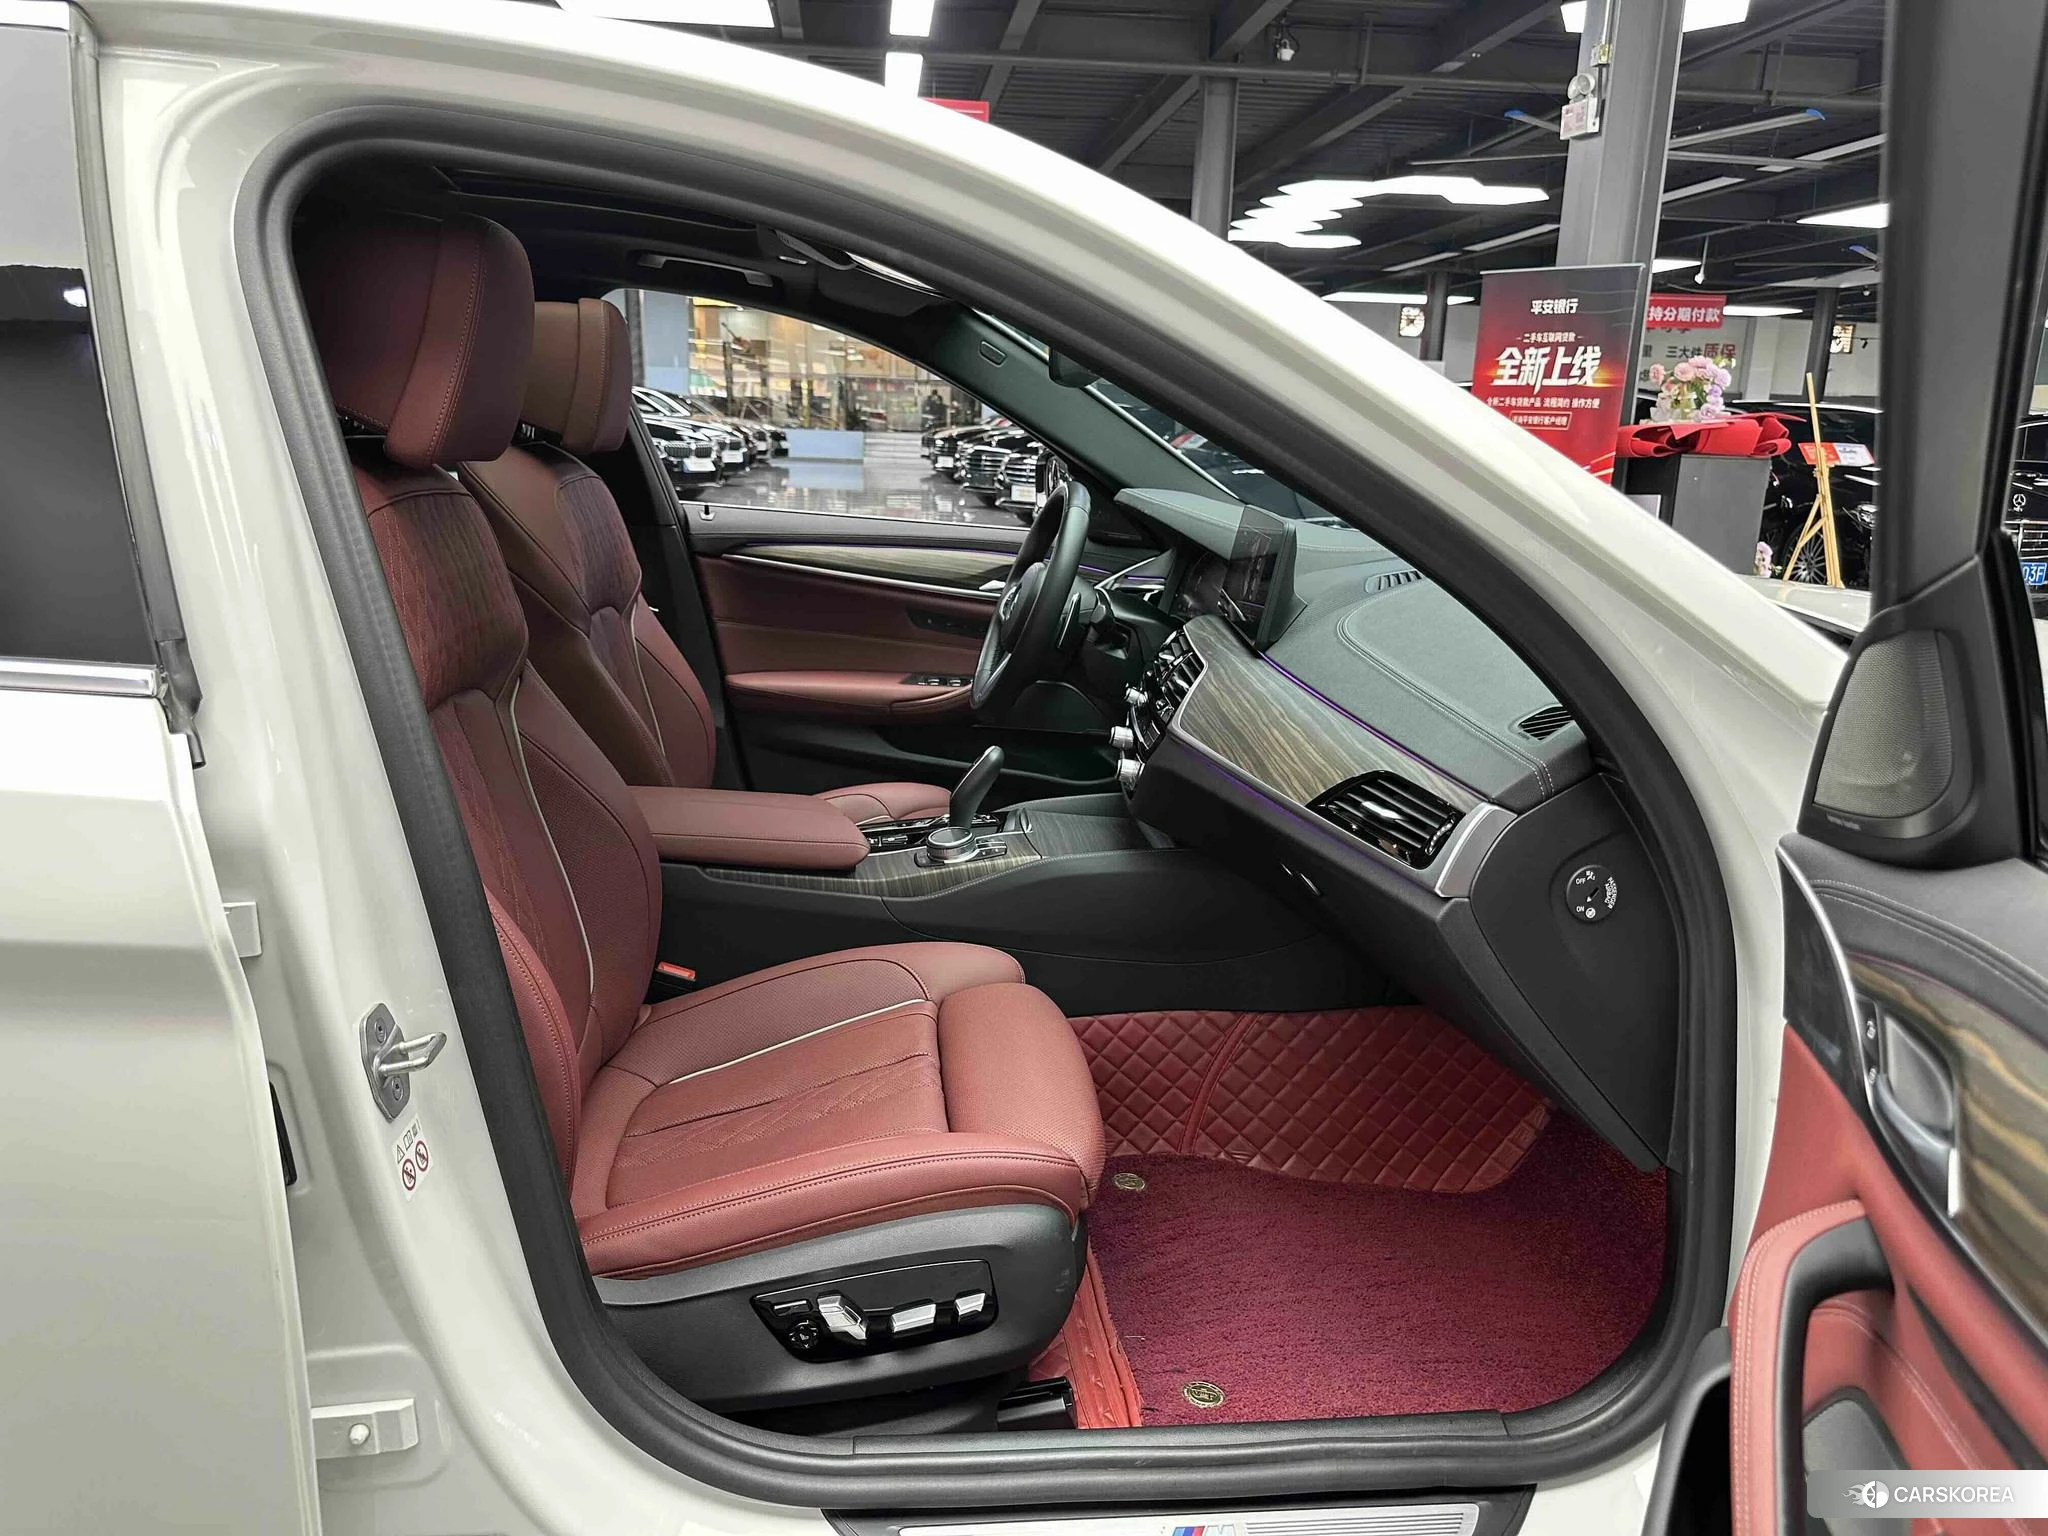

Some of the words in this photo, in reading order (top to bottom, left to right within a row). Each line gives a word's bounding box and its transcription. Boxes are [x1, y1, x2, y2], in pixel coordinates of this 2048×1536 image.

[1530, 298, 1579, 315] 平安银行
[1648, 306, 1721, 323] 持分期付款
[1492, 345, 1602, 395] 全新上线
[1576, 905, 1585, 913] ON
